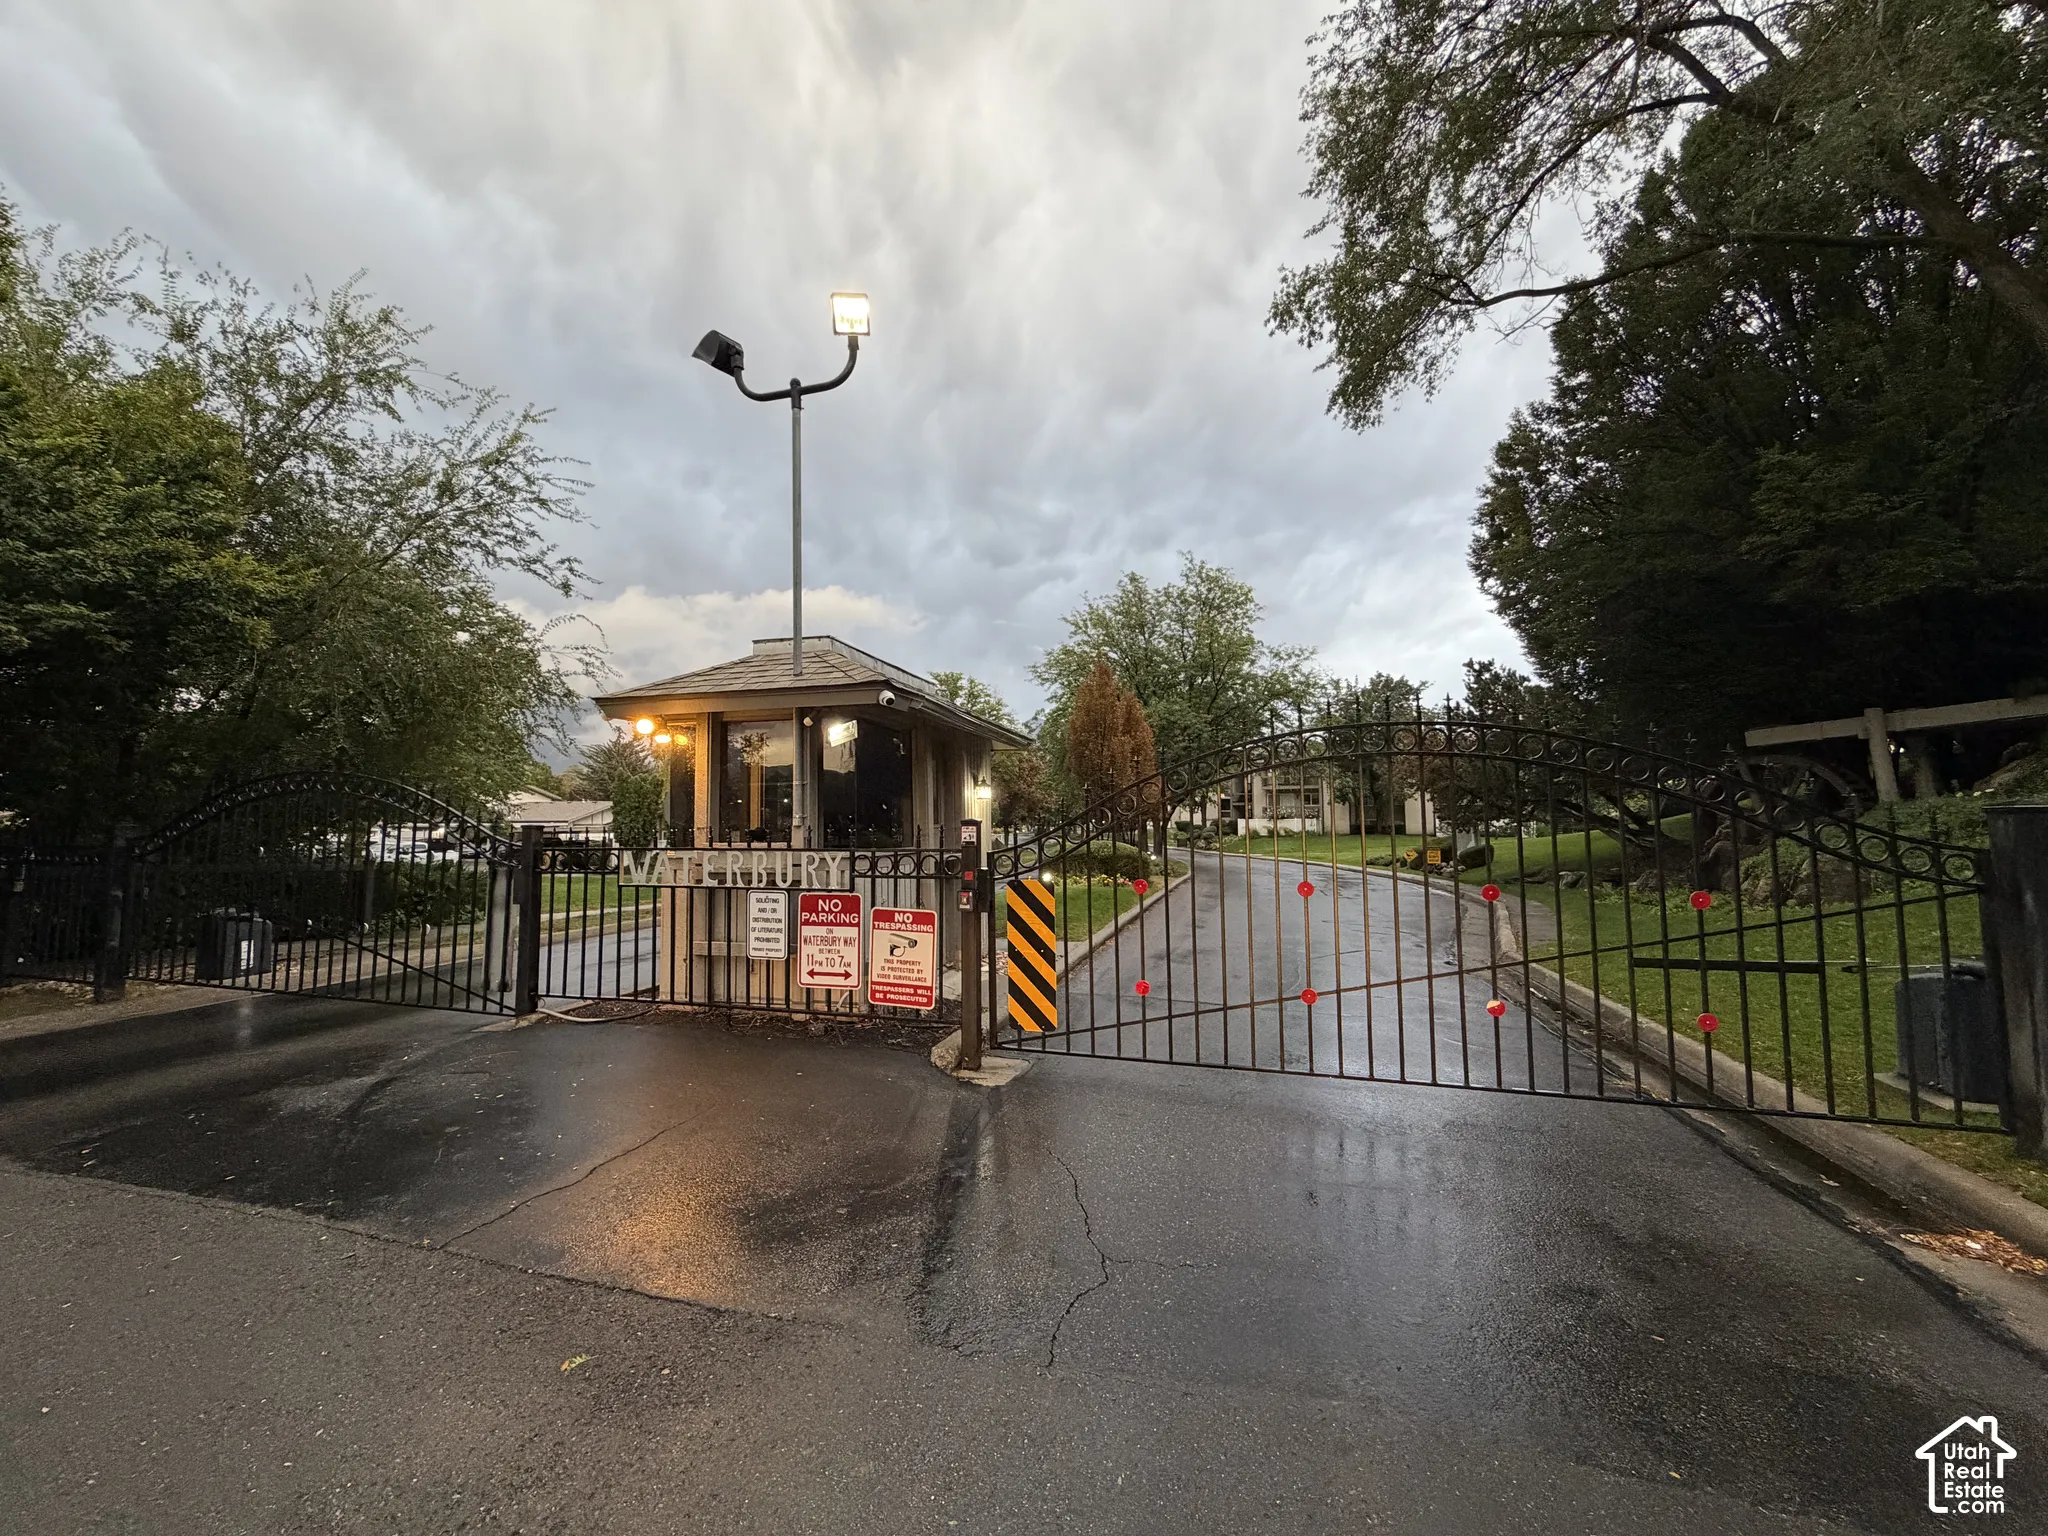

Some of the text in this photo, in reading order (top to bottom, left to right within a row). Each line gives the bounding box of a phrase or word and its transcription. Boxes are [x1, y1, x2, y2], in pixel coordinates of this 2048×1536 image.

[626, 850, 845, 889] WATERBURY
[818, 899, 842, 912] NO
[801, 912, 859, 924] PARKING
[894, 912, 912, 923] NO
[874, 922, 933, 932] TRESPASSING
[803, 935, 856, 947] WATERBURY WAY
[825, 958, 836, 968] TO
[892, 974, 926, 982] SURVEILLANCE
[872, 985, 914, 994] TRESPASSERS
[886, 994, 928, 1002] PROSECUTED
